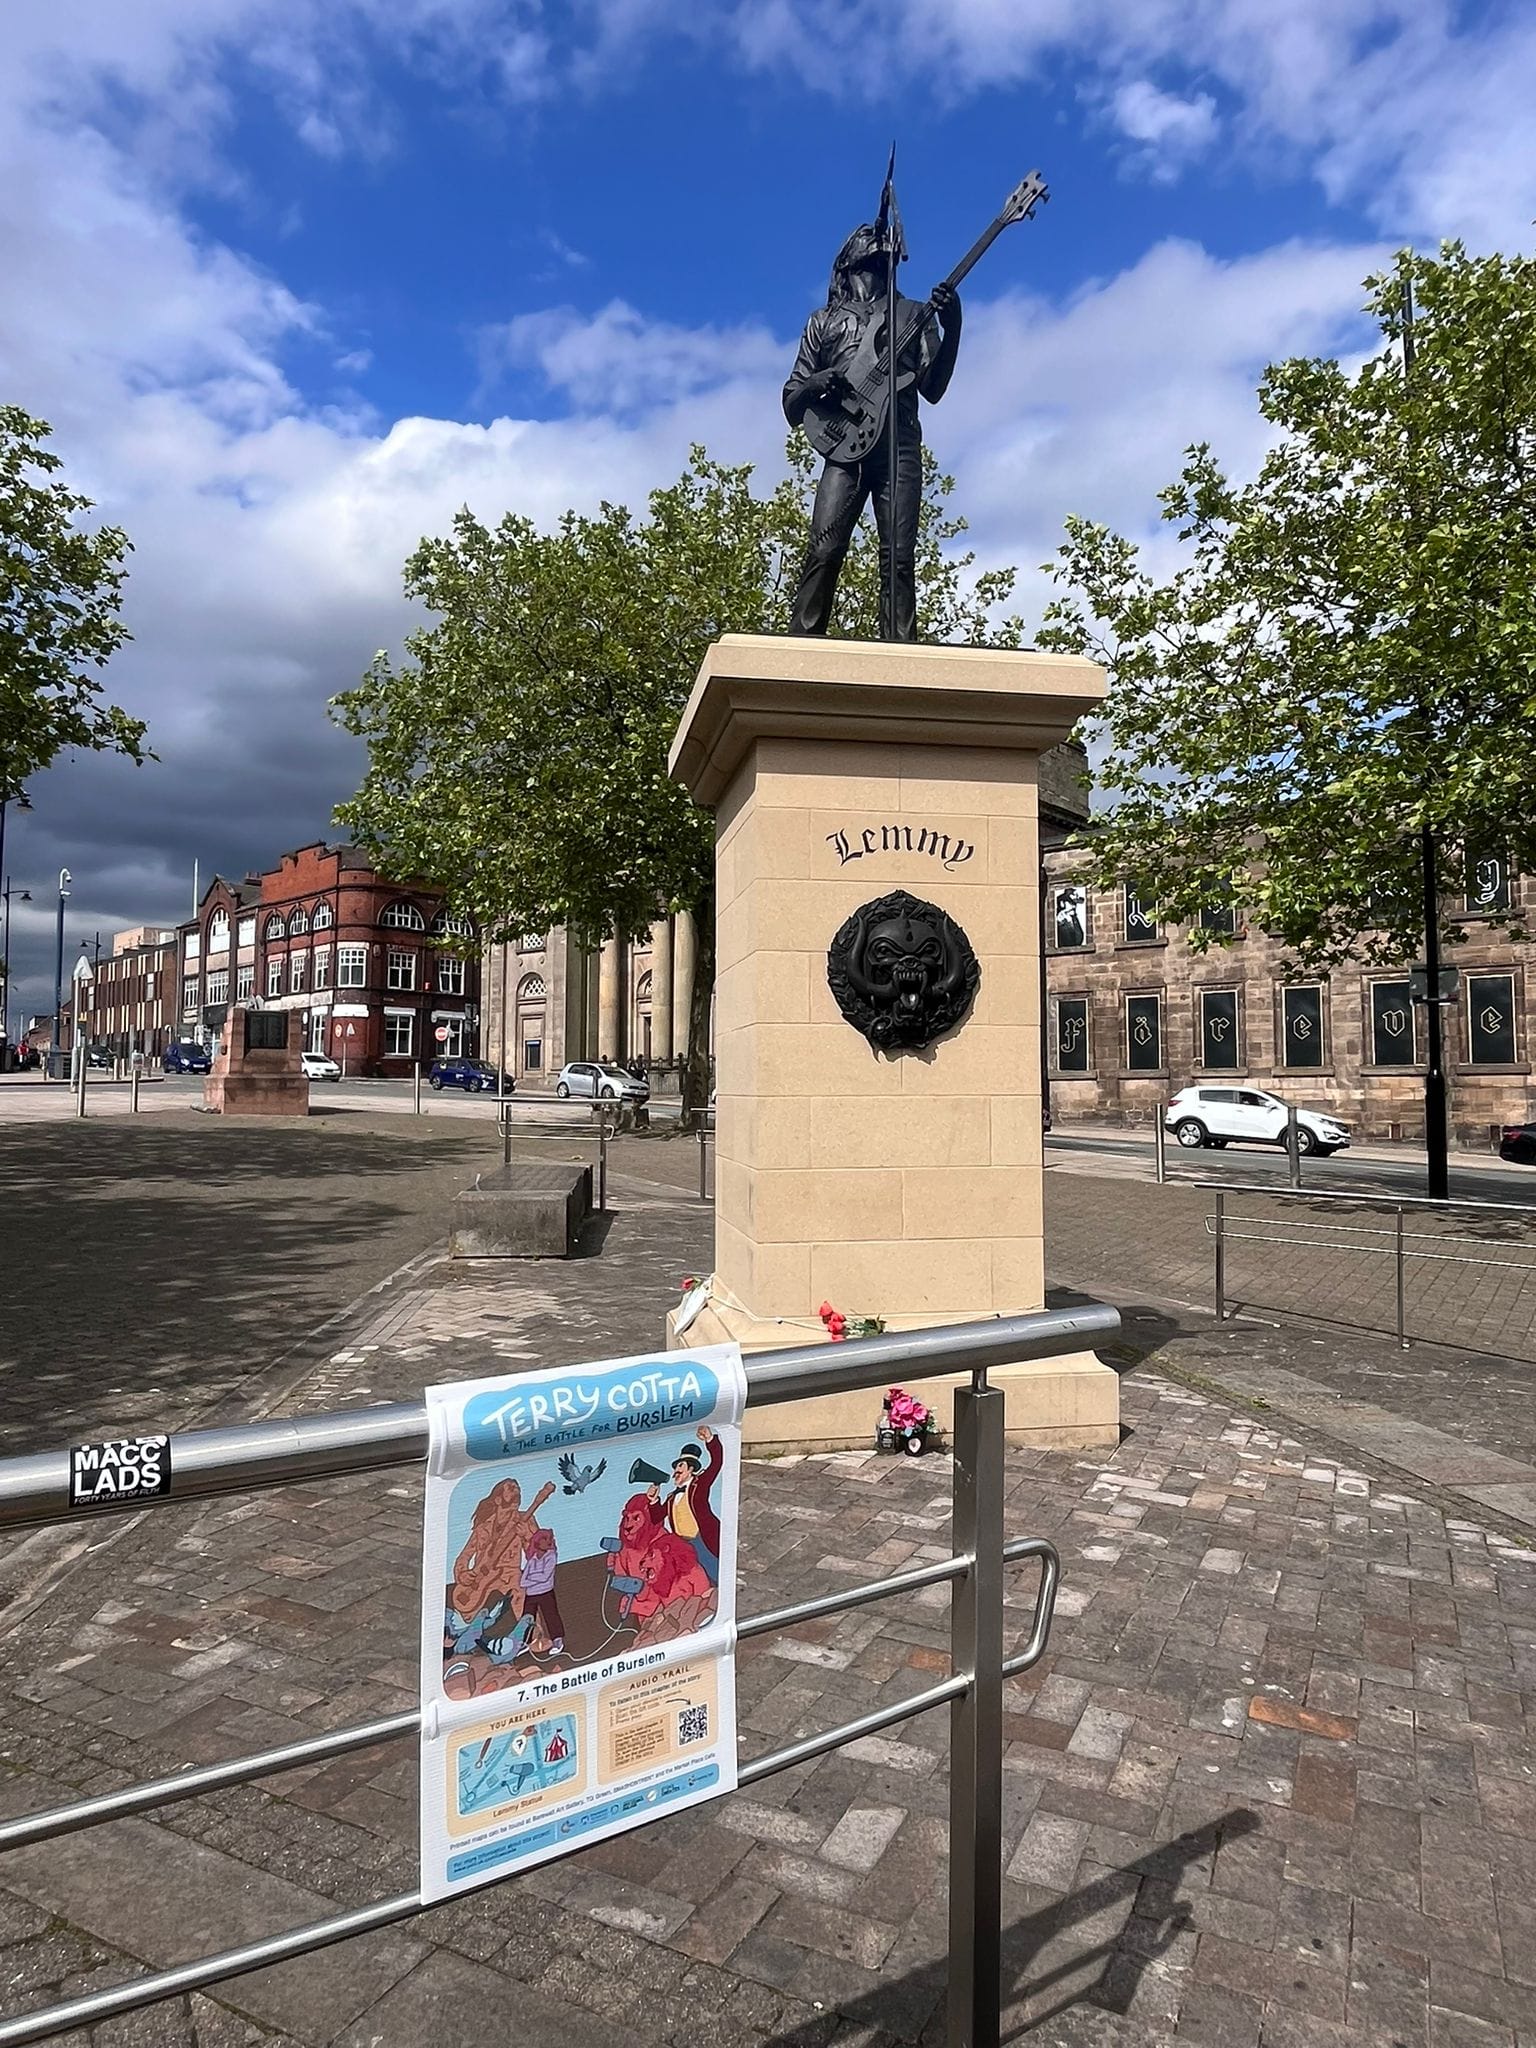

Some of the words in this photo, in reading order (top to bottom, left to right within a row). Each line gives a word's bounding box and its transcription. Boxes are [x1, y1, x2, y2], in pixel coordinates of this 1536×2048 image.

[826, 825, 974, 872] Lemmy
[481, 1384, 600, 1441] TERRY
[608, 1371, 701, 1411] COTTA
[516, 1438, 537, 1449] THE
[544, 1428, 585, 1444] BATTLE
[592, 1423, 611, 1434] FOR
[616, 1401, 694, 1433] BURSLEM
[75, 1442, 161, 1471] MACC
[74, 1462, 162, 1497] LADS
[517, 1690, 530, 1703] 7.
[533, 1684, 557, 1698] The
[561, 1671, 598, 1689] Battle
[601, 1667, 613, 1679] of
[617, 1651, 666, 1673] Burslem
[629, 1675, 659, 1691] AUDIO
[662, 1665, 690, 1680] TRAIL
[490, 1720, 507, 1731] YOU
[509, 1715, 524, 1725] ARE
[526, 1708, 547, 1720] HERE
